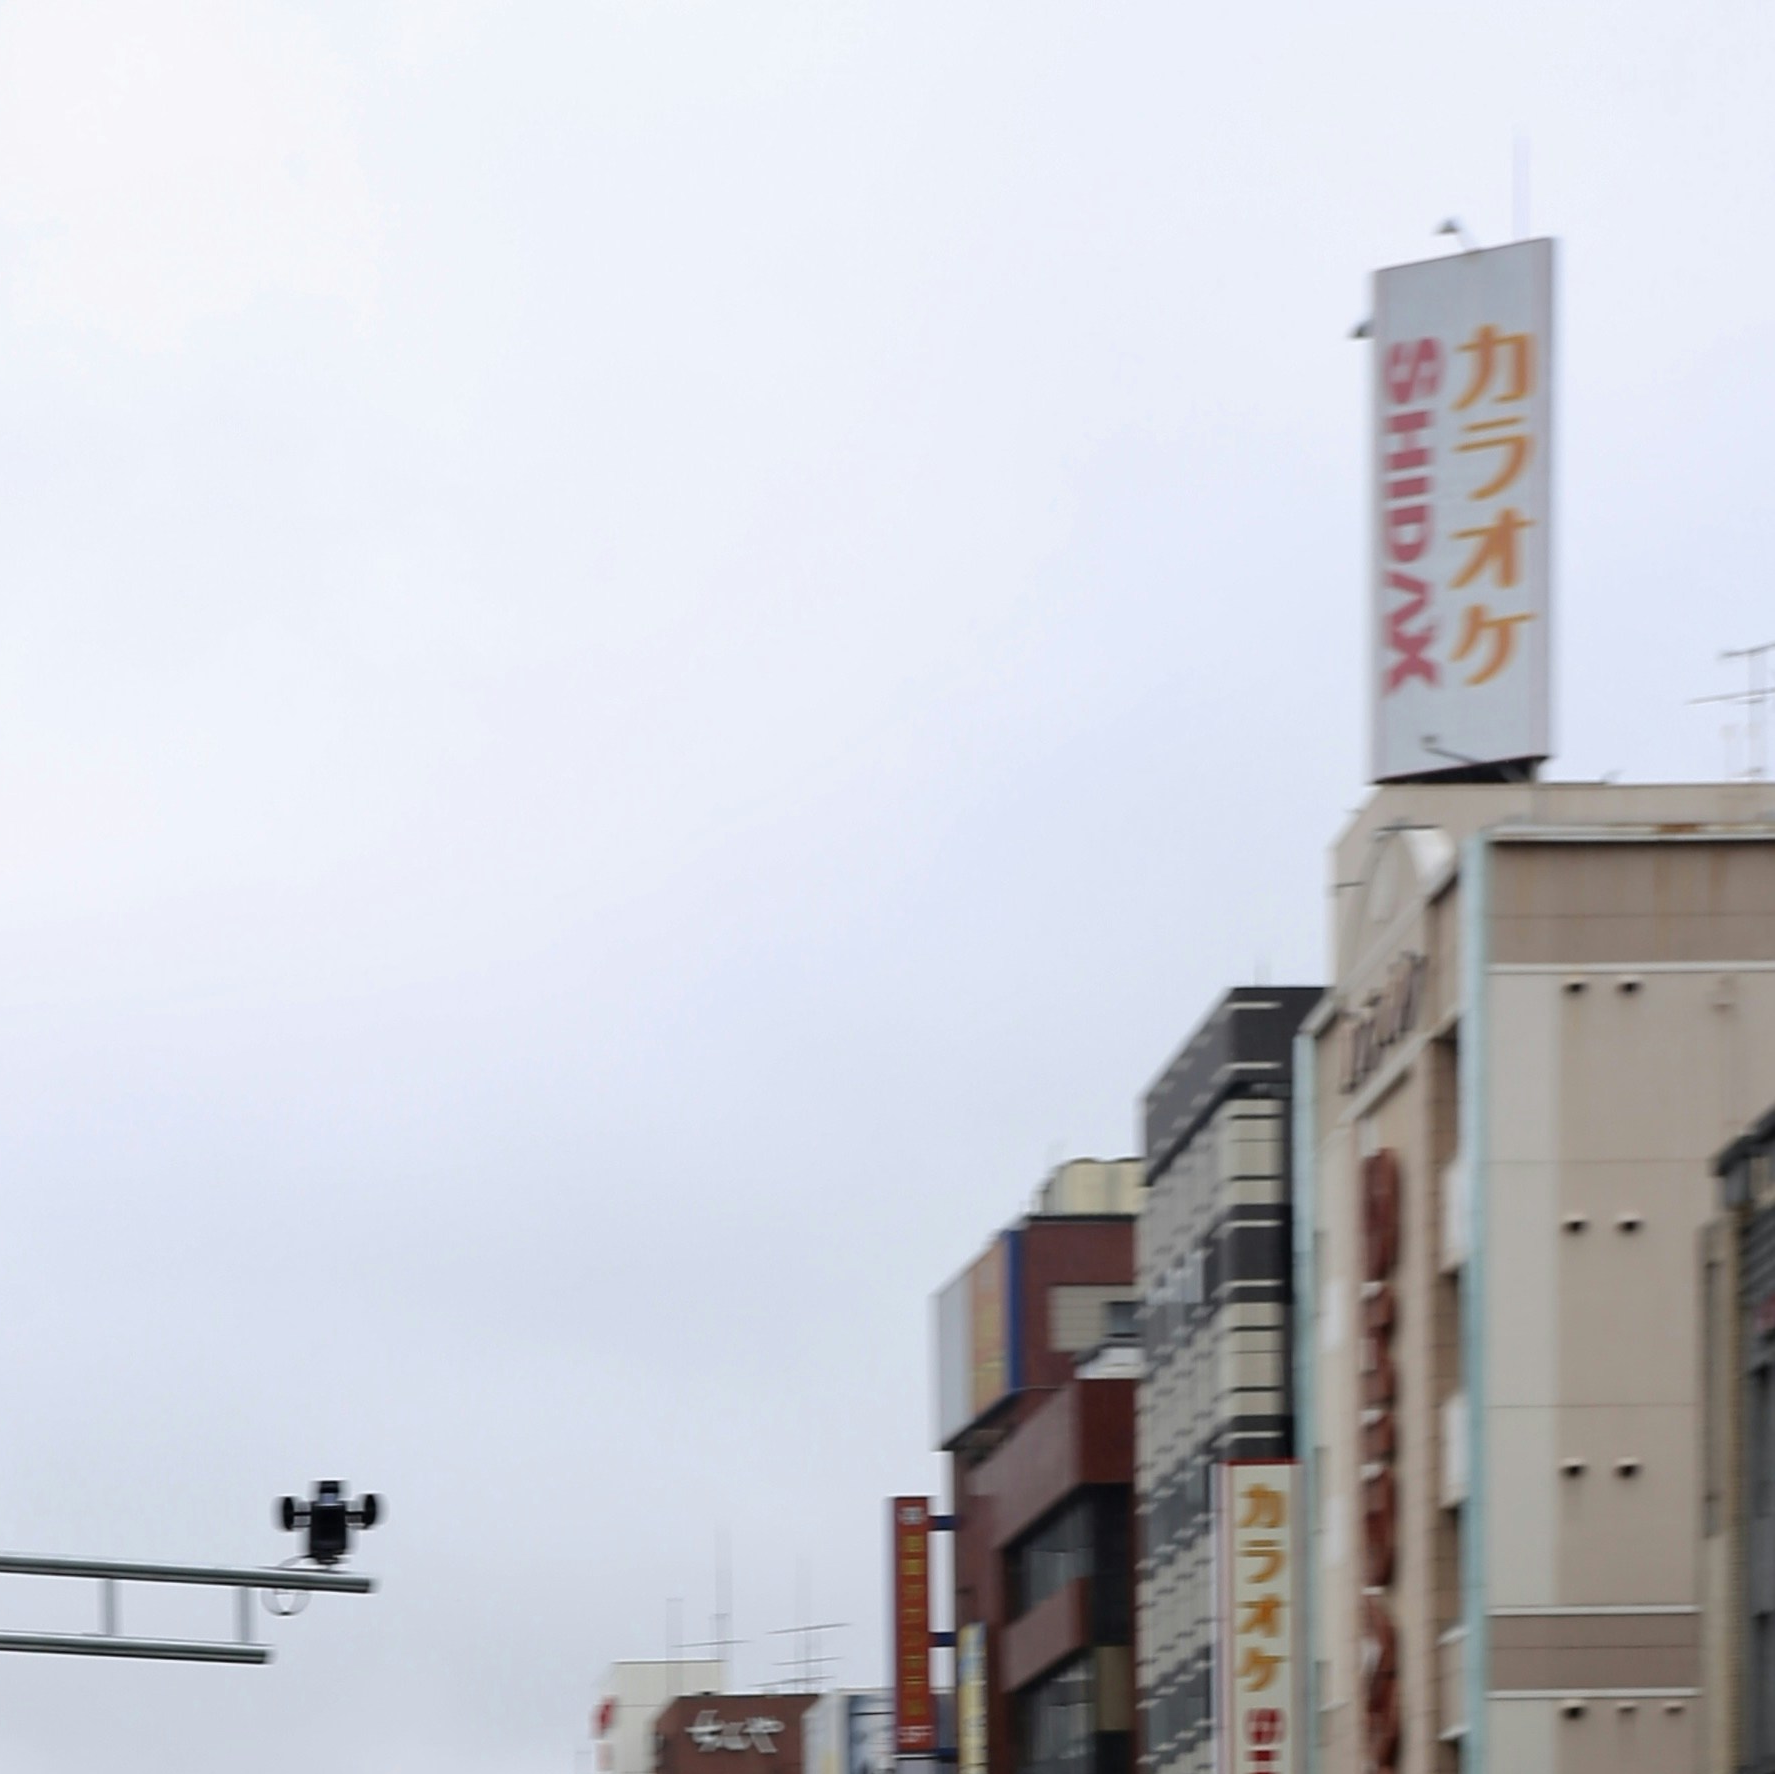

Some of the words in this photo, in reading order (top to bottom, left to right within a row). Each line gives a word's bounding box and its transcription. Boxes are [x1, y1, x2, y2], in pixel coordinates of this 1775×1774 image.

[1382, 336, 1445, 697] SHIDAX
[1450, 324, 1538, 686] カラオケ
[1236, 1483, 1287, 1692] カラオケ
